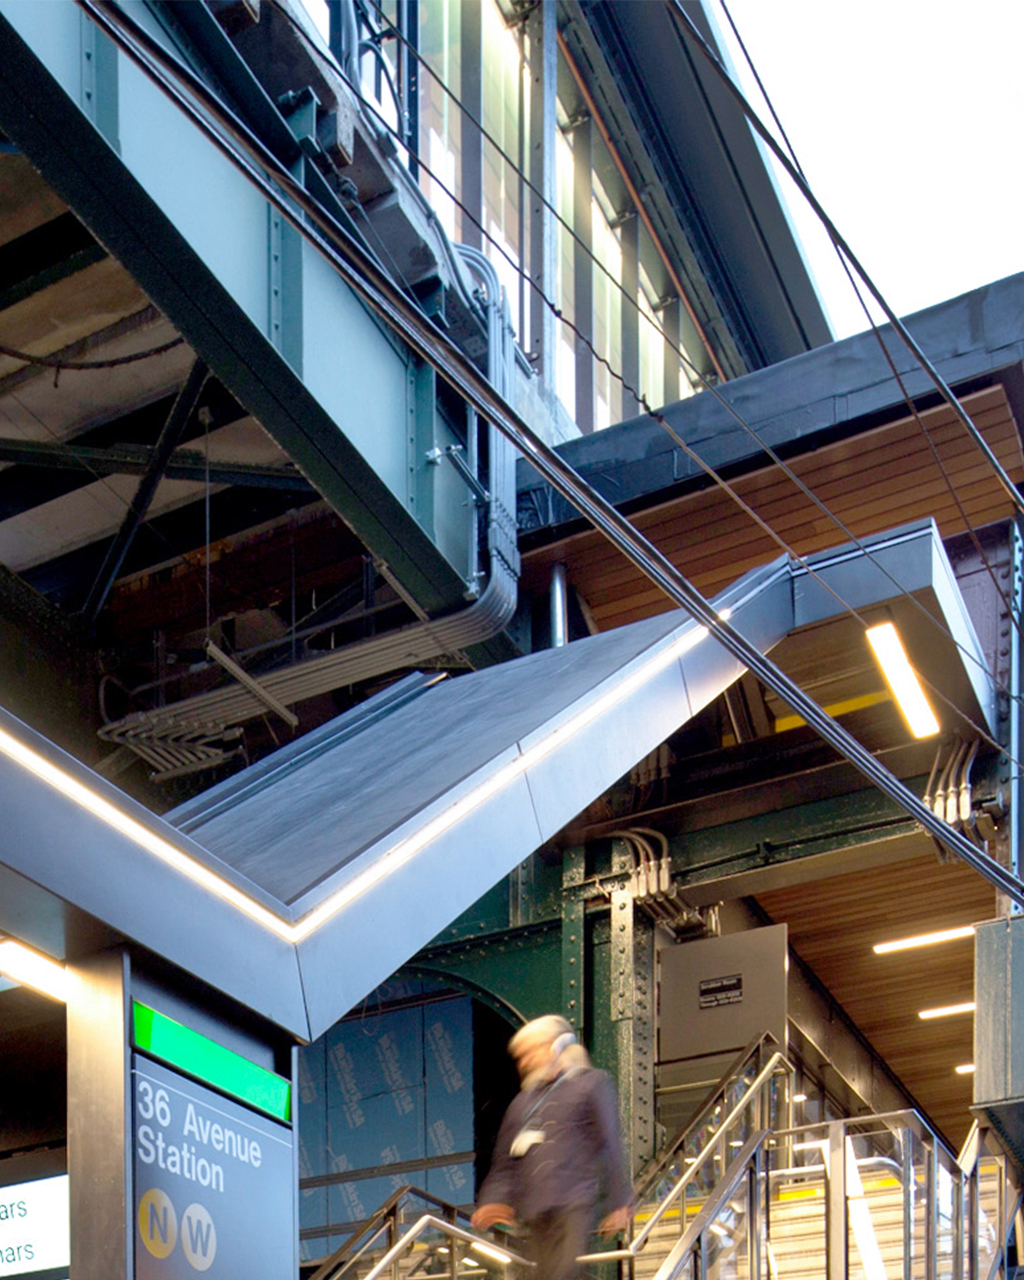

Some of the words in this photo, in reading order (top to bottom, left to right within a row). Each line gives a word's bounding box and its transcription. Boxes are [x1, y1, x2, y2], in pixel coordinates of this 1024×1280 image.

[138, 1081, 171, 1127] 36
[183, 1103, 263, 1168] Avenue
[138, 1125, 224, 1193] Station
[149, 1202, 167, 1245] N
[187, 1215, 211, 1257] W
